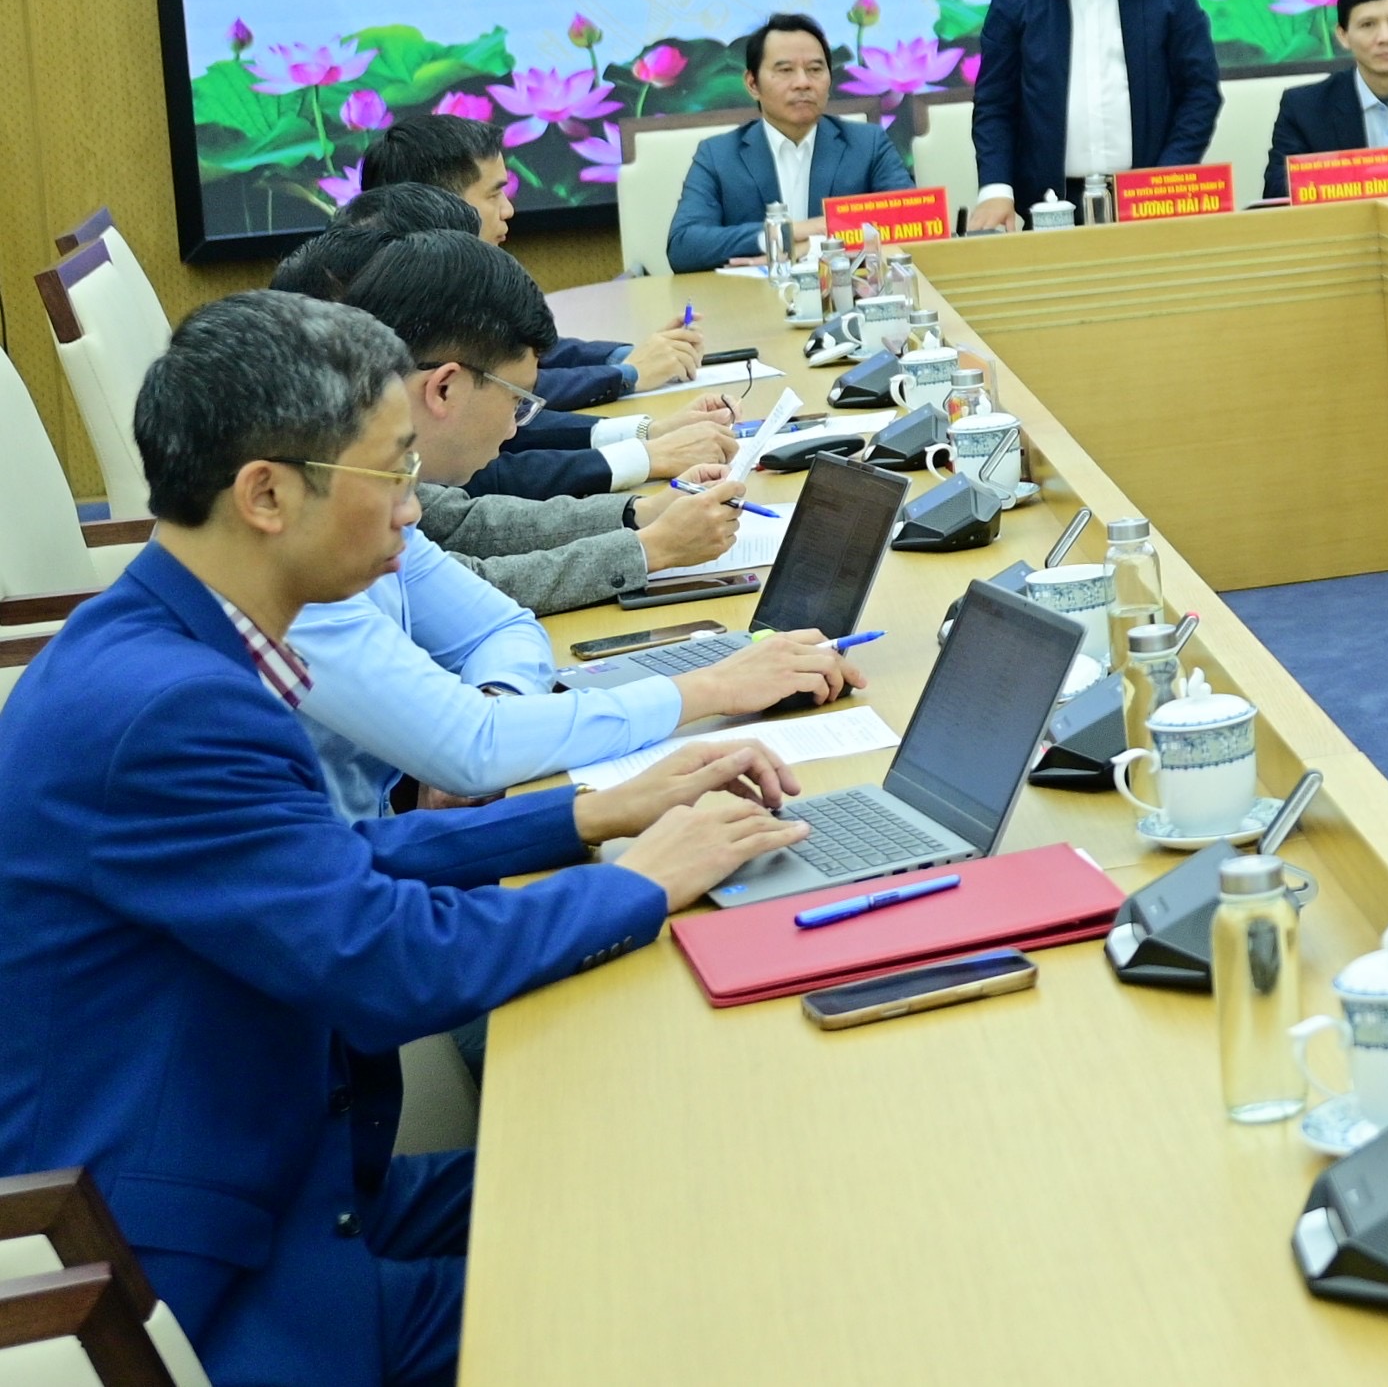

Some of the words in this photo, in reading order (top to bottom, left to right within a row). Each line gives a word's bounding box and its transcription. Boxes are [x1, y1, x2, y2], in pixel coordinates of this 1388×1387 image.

[1320, 182, 1362, 200] THANH
[1178, 193, 1199, 214] HẢI
[1203, 194, 1220, 212] ÂU
[894, 220, 923, 239] ANH
